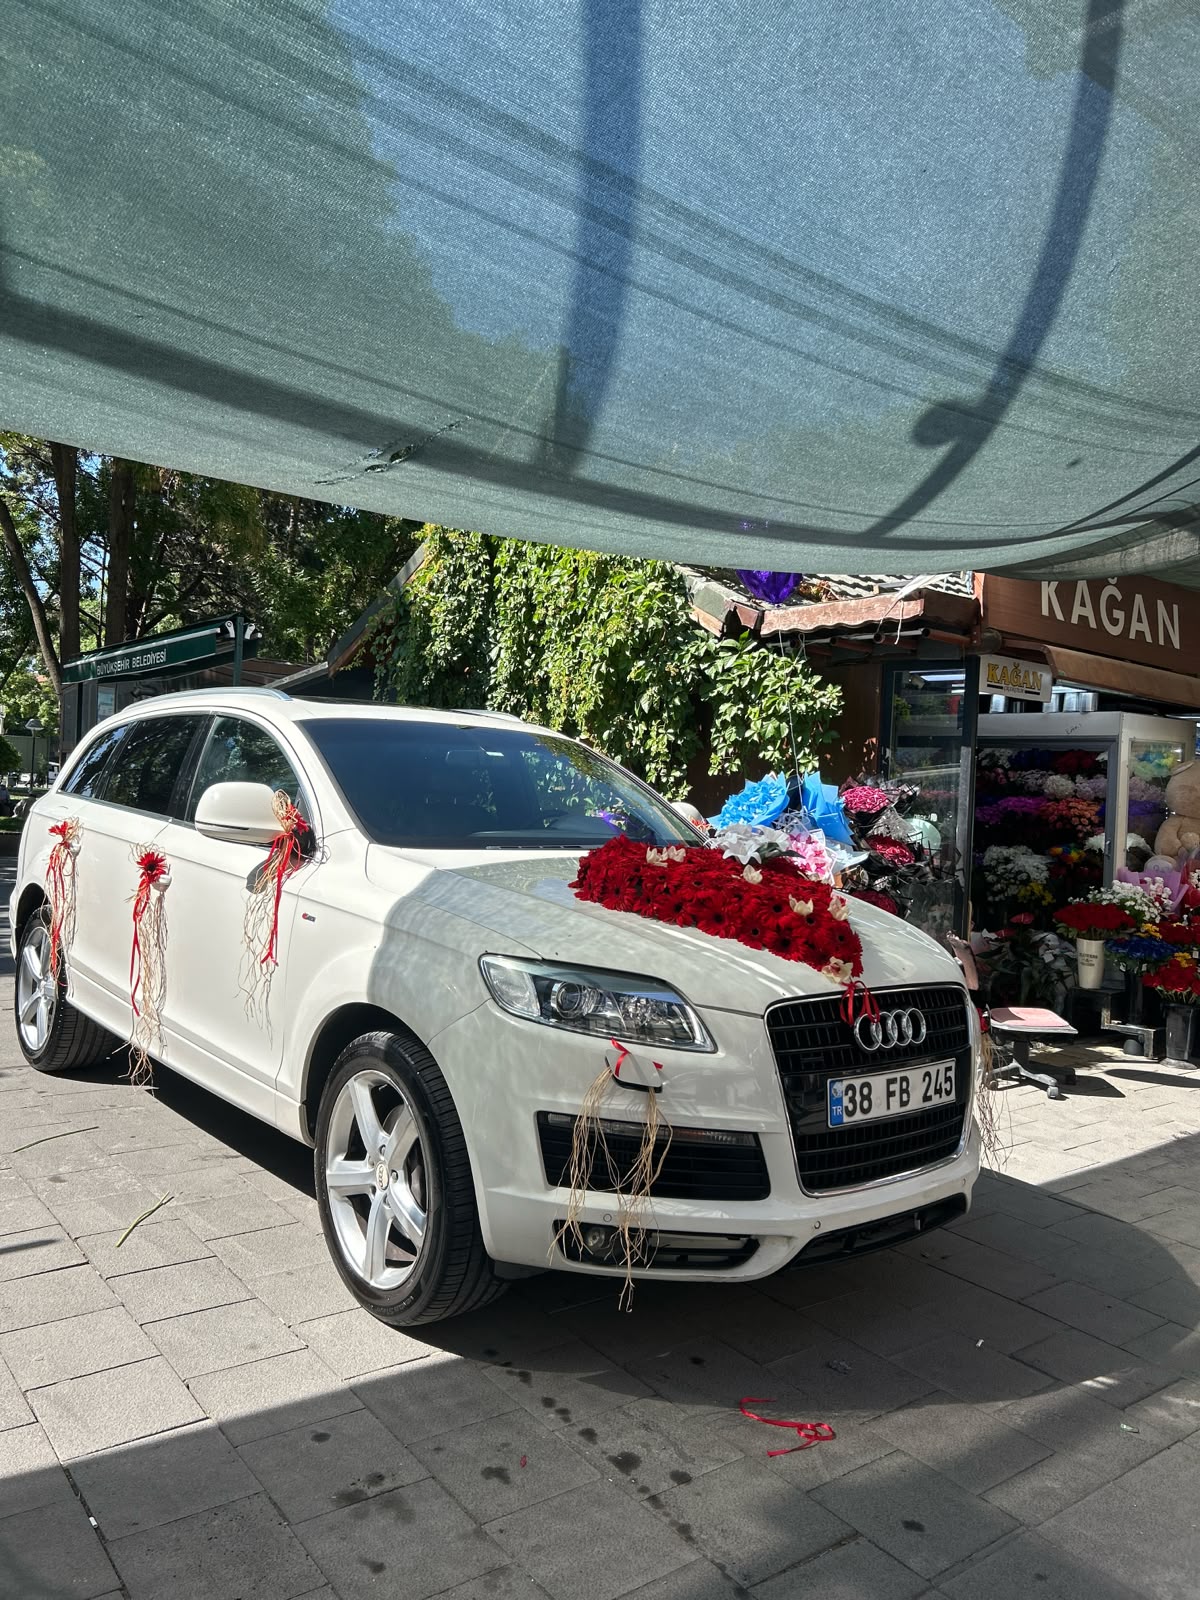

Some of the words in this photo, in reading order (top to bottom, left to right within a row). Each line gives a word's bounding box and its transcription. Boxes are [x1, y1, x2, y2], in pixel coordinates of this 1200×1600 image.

[1041, 577, 1180, 650] KAĞAN
[96, 657, 130, 676] BÜYÜKŞEHİR
[132, 649, 167, 668] BELEDİYESİ
[987, 662, 1043, 691] KAĞAN
[844, 1081, 873, 1118] 38
[886, 1075, 910, 1111] FB
[922, 1066, 953, 1103] 245
[832, 1106, 842, 1115] TR
